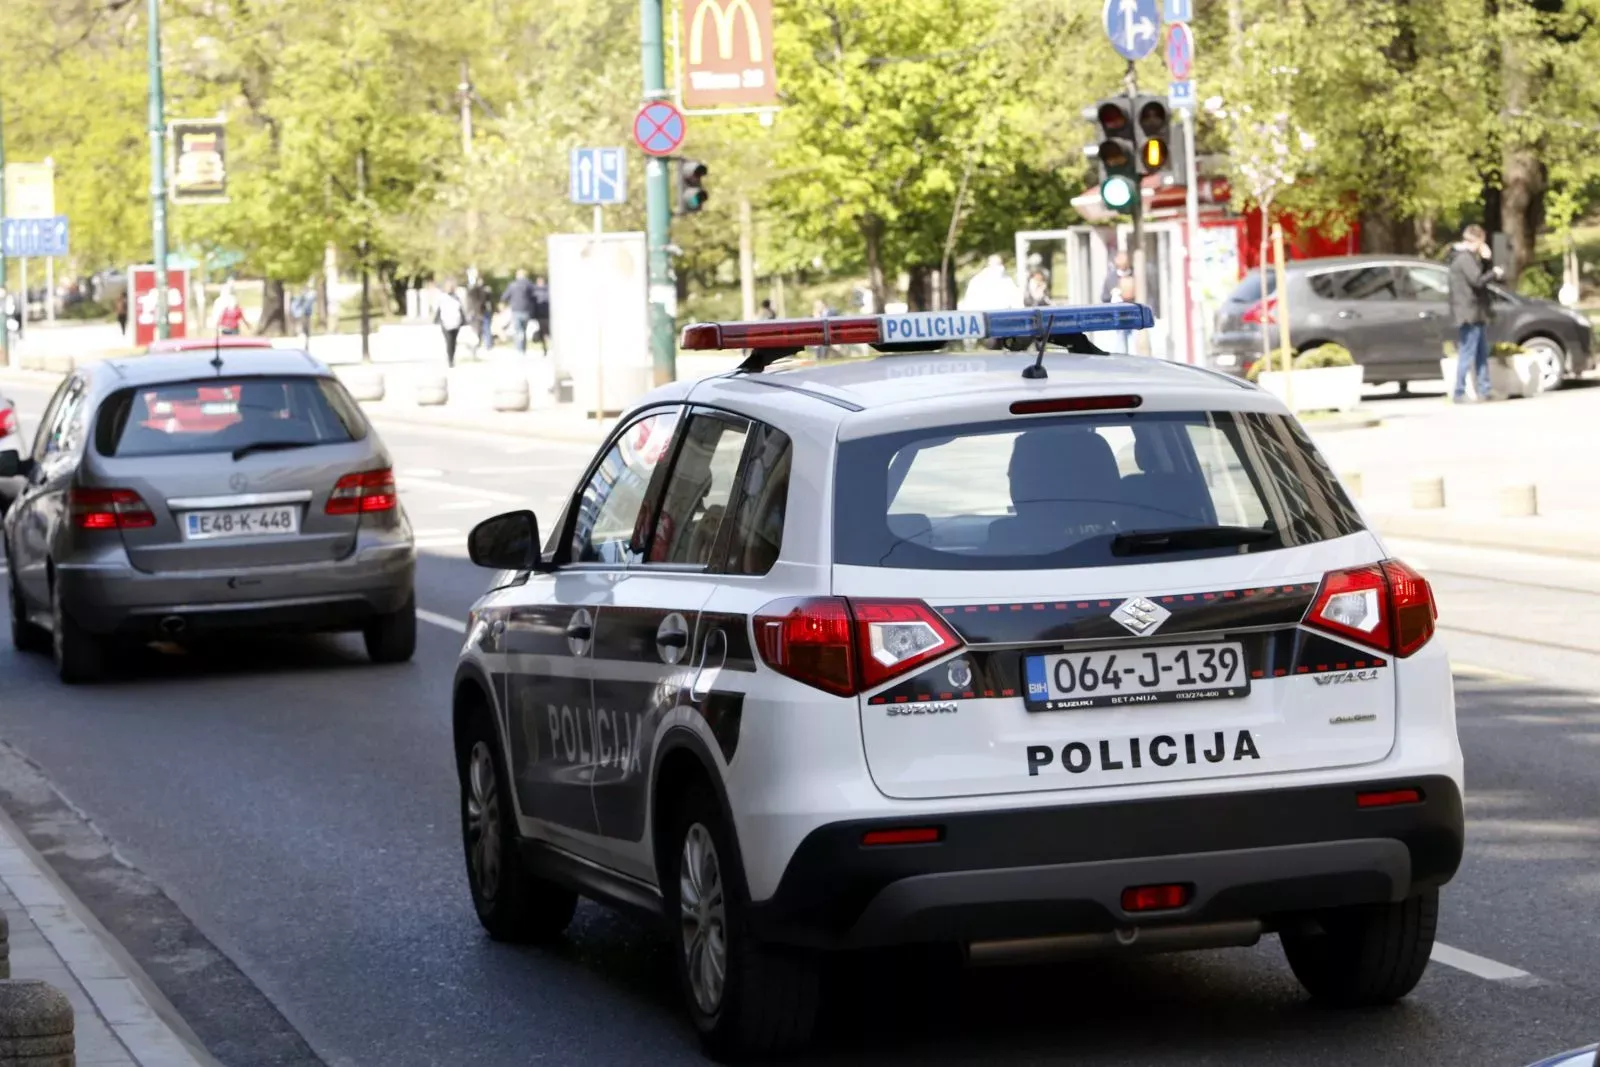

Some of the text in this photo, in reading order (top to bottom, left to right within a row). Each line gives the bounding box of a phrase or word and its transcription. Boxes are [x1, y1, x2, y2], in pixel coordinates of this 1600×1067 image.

[886, 315, 980, 339] POLICIJA
[200, 511, 292, 533] E48-K-448
[1053, 647, 1239, 693] 064-J-139
[1313, 669, 1378, 686] VITARA
[1028, 683, 1048, 694] BIH
[886, 701, 958, 716] SUZUKI
[1057, 700, 1093, 708] SUZUKI
[1111, 695, 1158, 704] BETANIJA
[547, 704, 643, 779] POLICIJA
[1026, 730, 1261, 776] POLICIJA
